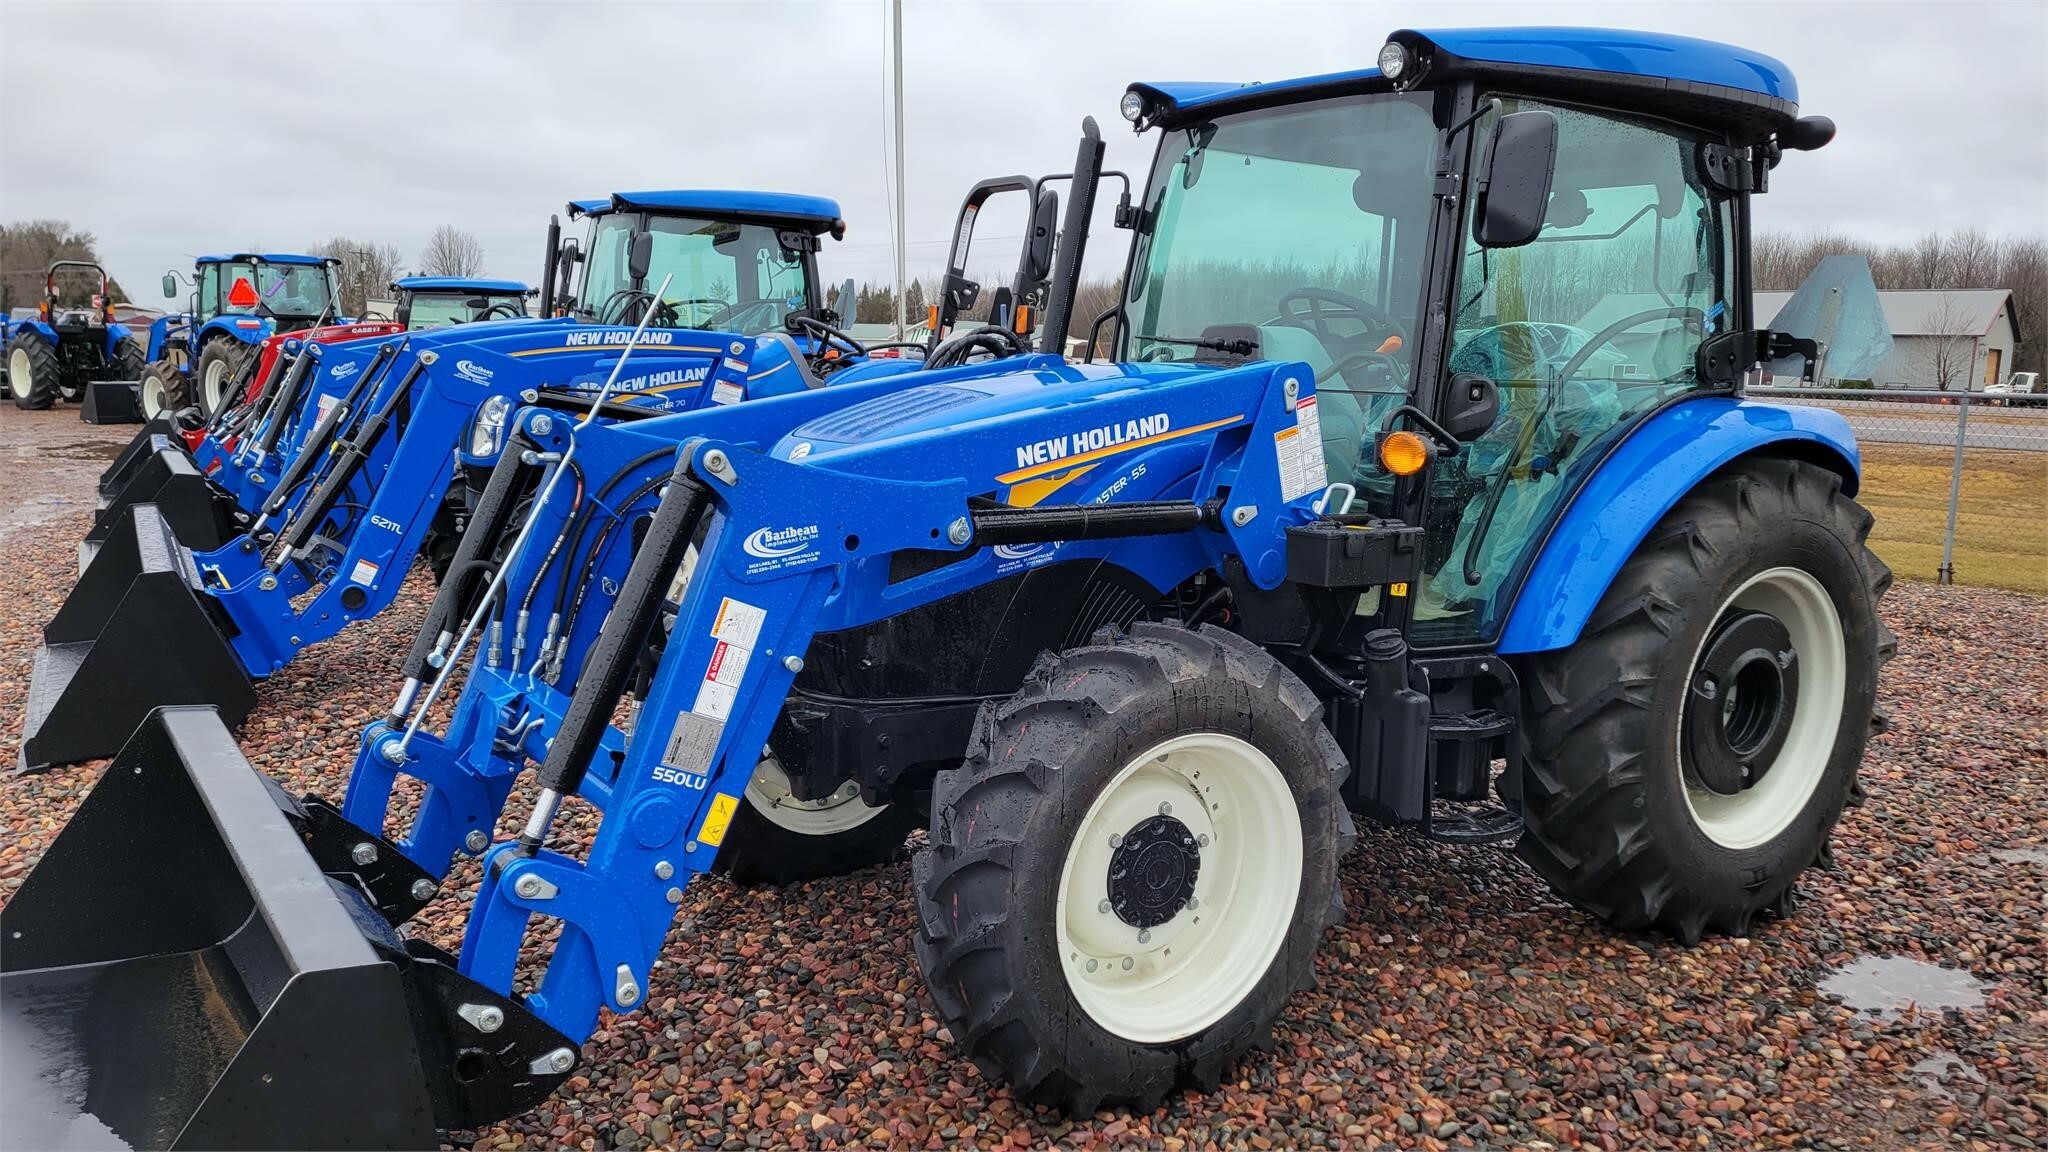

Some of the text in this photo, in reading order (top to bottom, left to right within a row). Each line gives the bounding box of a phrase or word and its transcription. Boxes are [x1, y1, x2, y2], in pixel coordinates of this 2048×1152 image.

[566, 331, 673, 346] NEW HOLAND
[610, 375, 647, 398] NEW
[675, 399, 686, 407] 70
[1016, 412, 1170, 468] NEW HOLLAND
[1131, 463, 1147, 480] 55
[370, 514, 403, 535] 621TL
[764, 525, 818, 543] Baribeau
[765, 537, 798, 548] Implement
[711, 644, 726, 672] DANGER
[651, 766, 708, 790] 550LU
